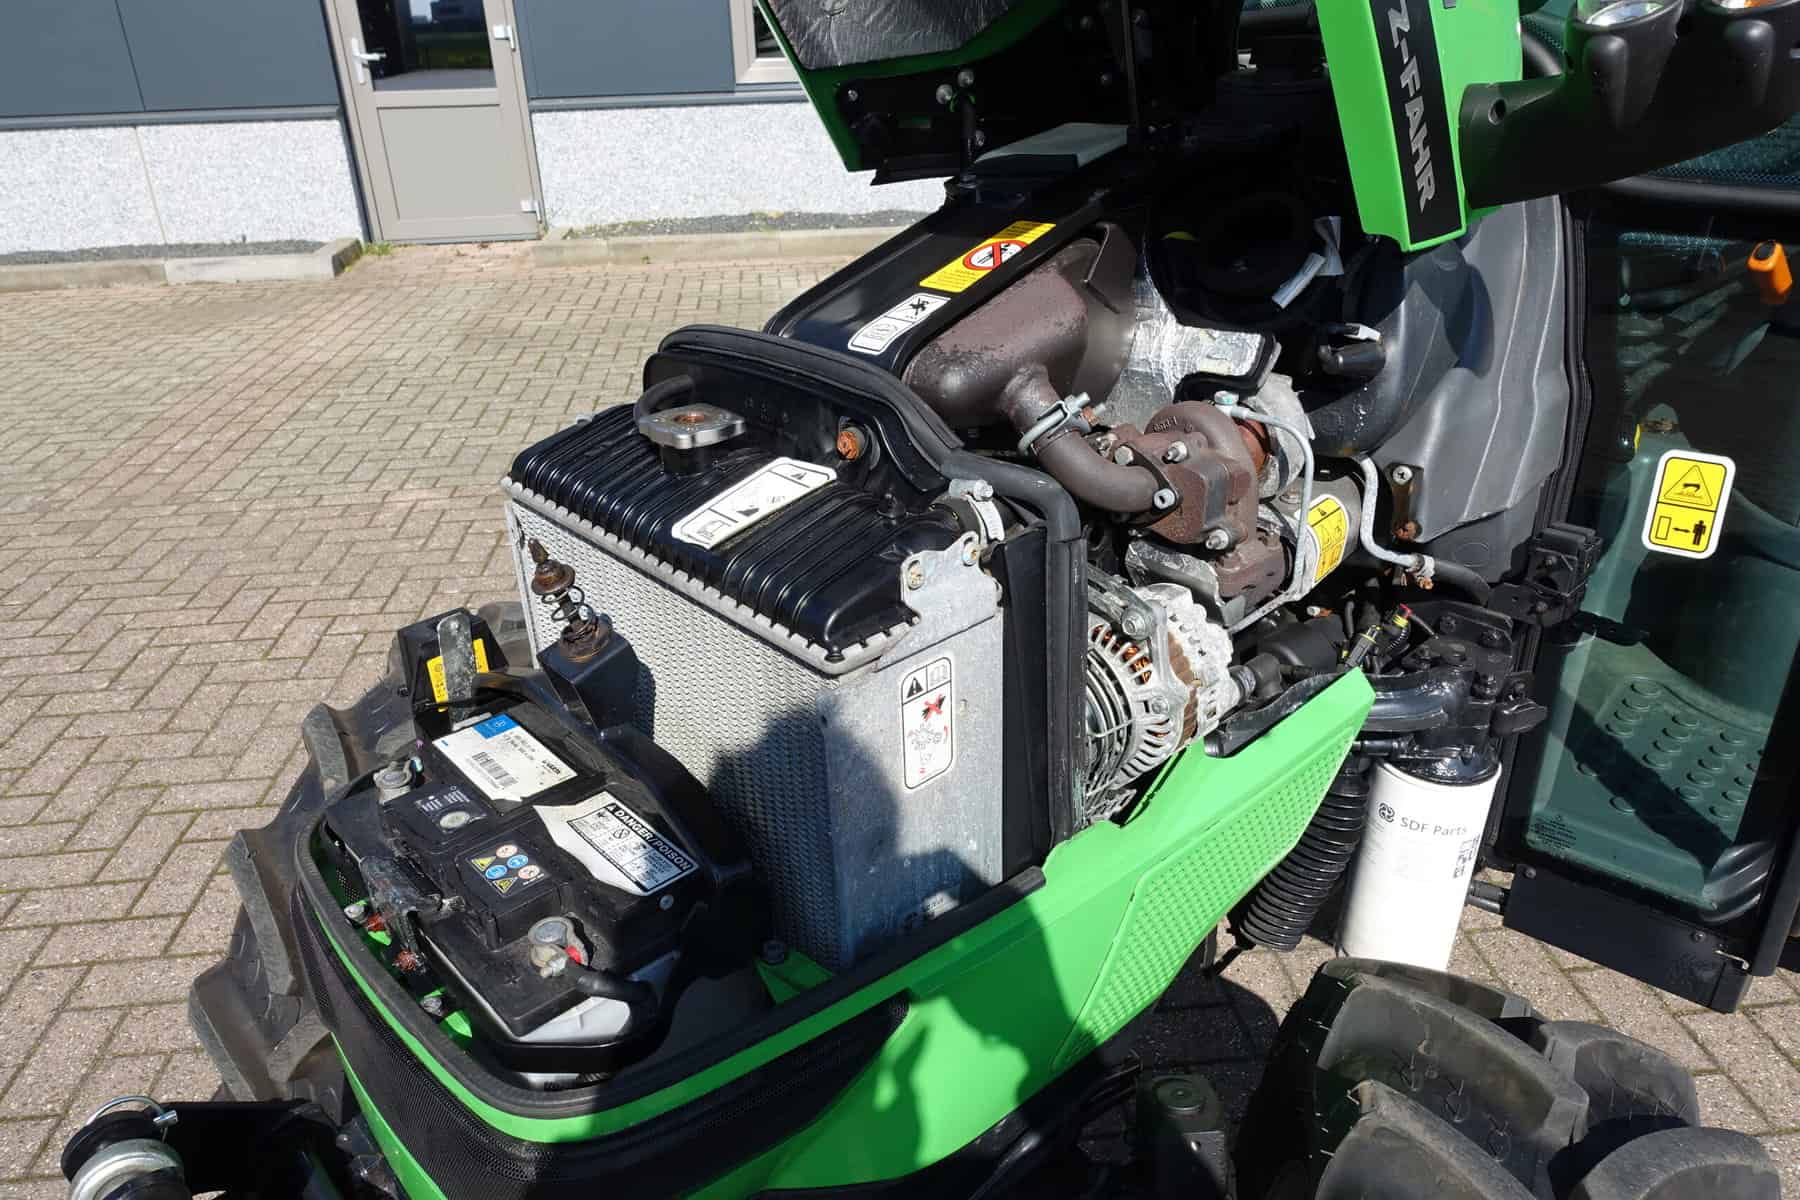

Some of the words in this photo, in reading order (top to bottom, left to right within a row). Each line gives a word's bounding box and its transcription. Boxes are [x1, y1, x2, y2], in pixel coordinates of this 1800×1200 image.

[614, 809, 692, 871] DANGER/POISON
[1400, 816, 1430, 833] SDF
[1433, 824, 1468, 837] Parts
